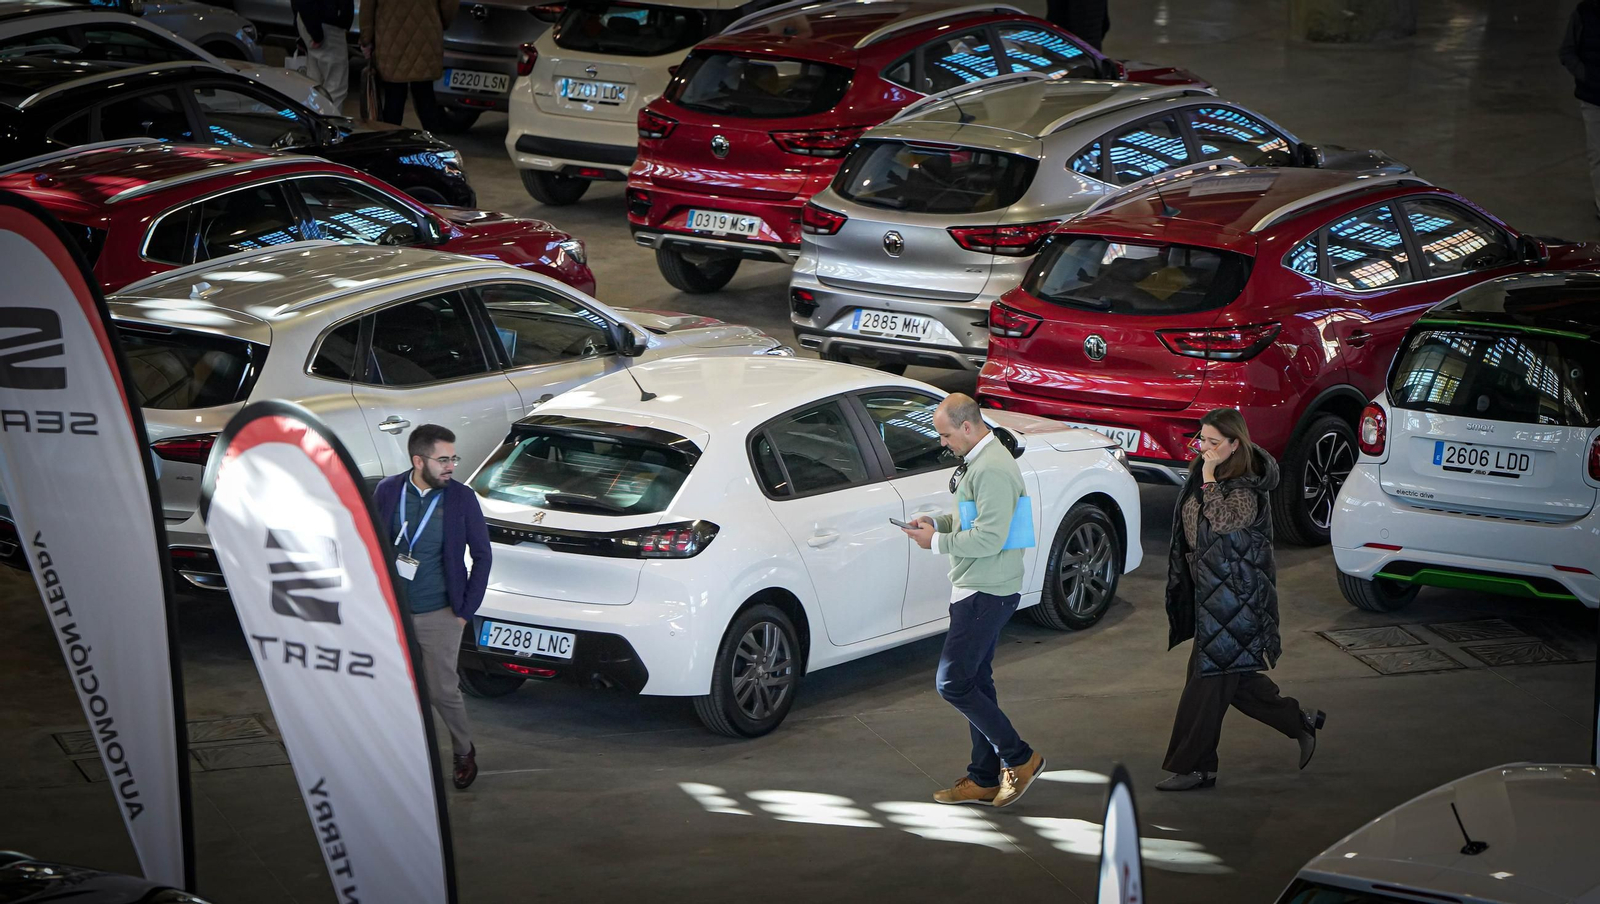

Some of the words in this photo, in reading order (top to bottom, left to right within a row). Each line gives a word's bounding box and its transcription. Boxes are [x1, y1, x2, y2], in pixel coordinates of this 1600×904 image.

[452, 74, 480, 87] 6220
[482, 75, 508, 90] LSN
[695, 213, 727, 229] 0319
[862, 313, 899, 331] 2885
[901, 317, 931, 335] MRV
[1466, 422, 1496, 433] smart
[1445, 446, 1490, 467] 2606
[1495, 451, 1530, 472] LDD
[1396, 489, 1419, 498] electric
[1419, 491, 1435, 499] drive
[492, 626, 533, 649] 7288
[536, 632, 569, 655] LNC
